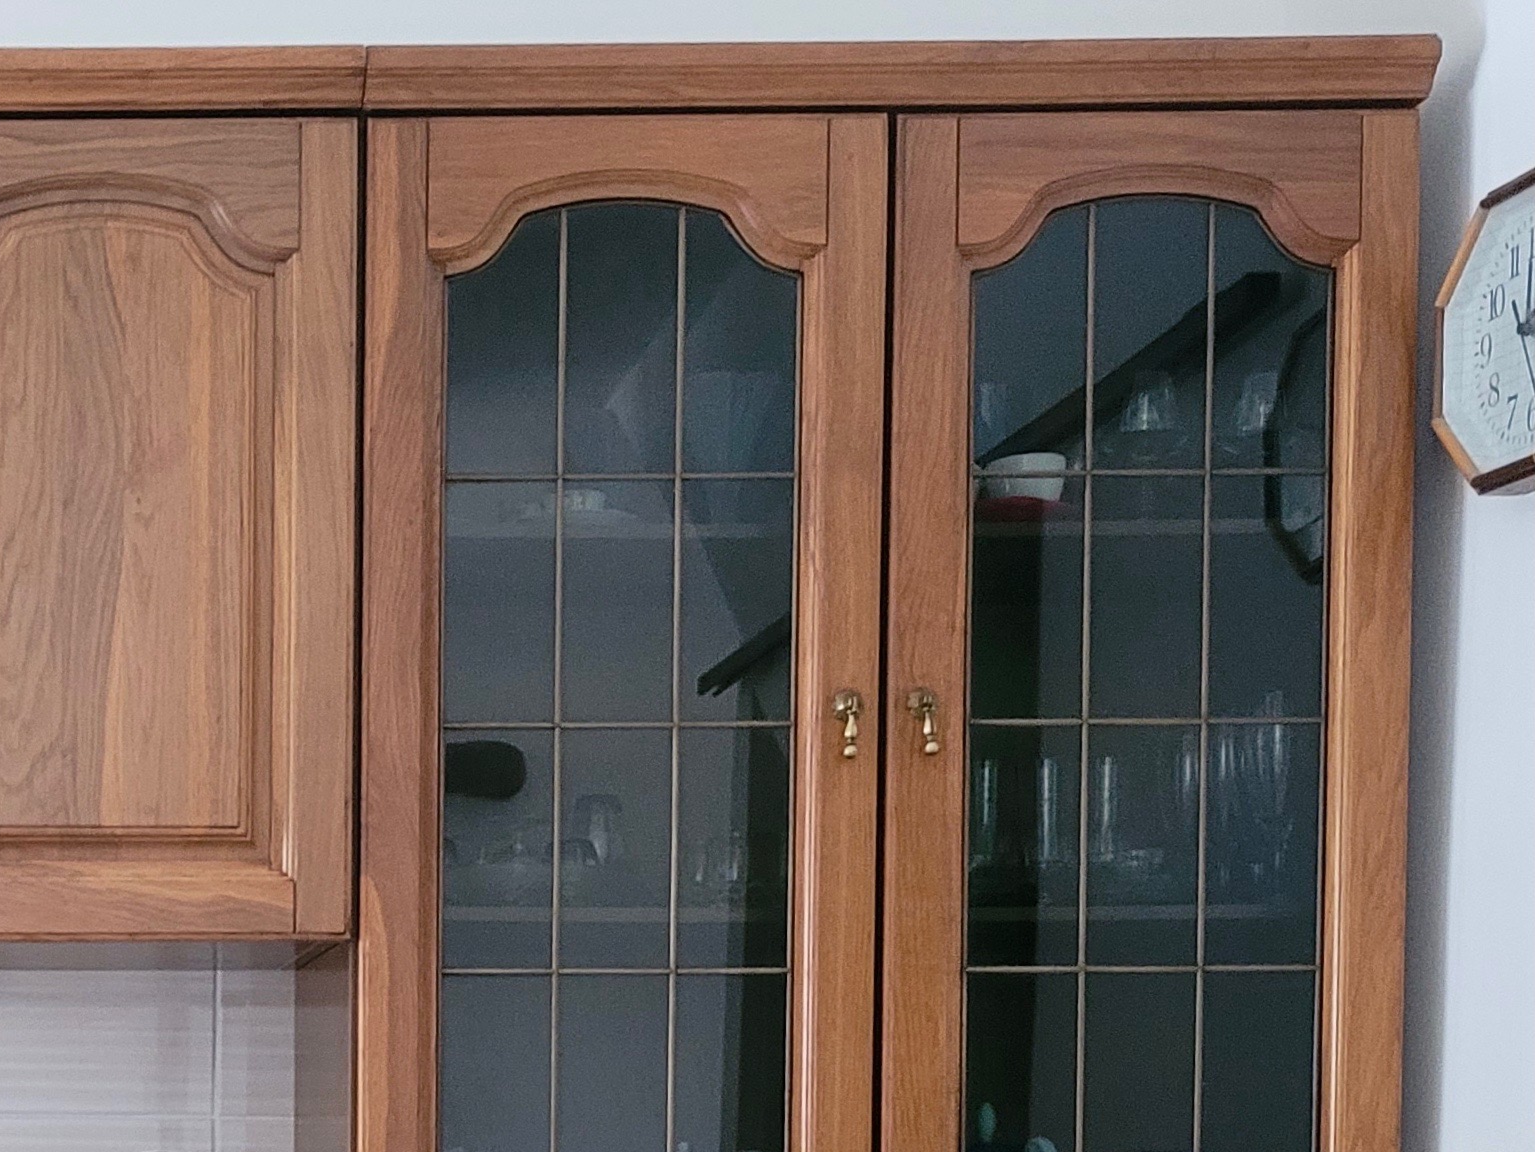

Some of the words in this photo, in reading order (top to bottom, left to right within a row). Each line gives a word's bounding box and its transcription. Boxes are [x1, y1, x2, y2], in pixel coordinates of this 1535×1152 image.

[1509, 244, 1520, 280] 11
[1488, 283, 1505, 322] 10
[1480, 332, 1492, 369] 9
[1487, 371, 1500, 408] 8
[1506, 393, 1519, 431] 7
